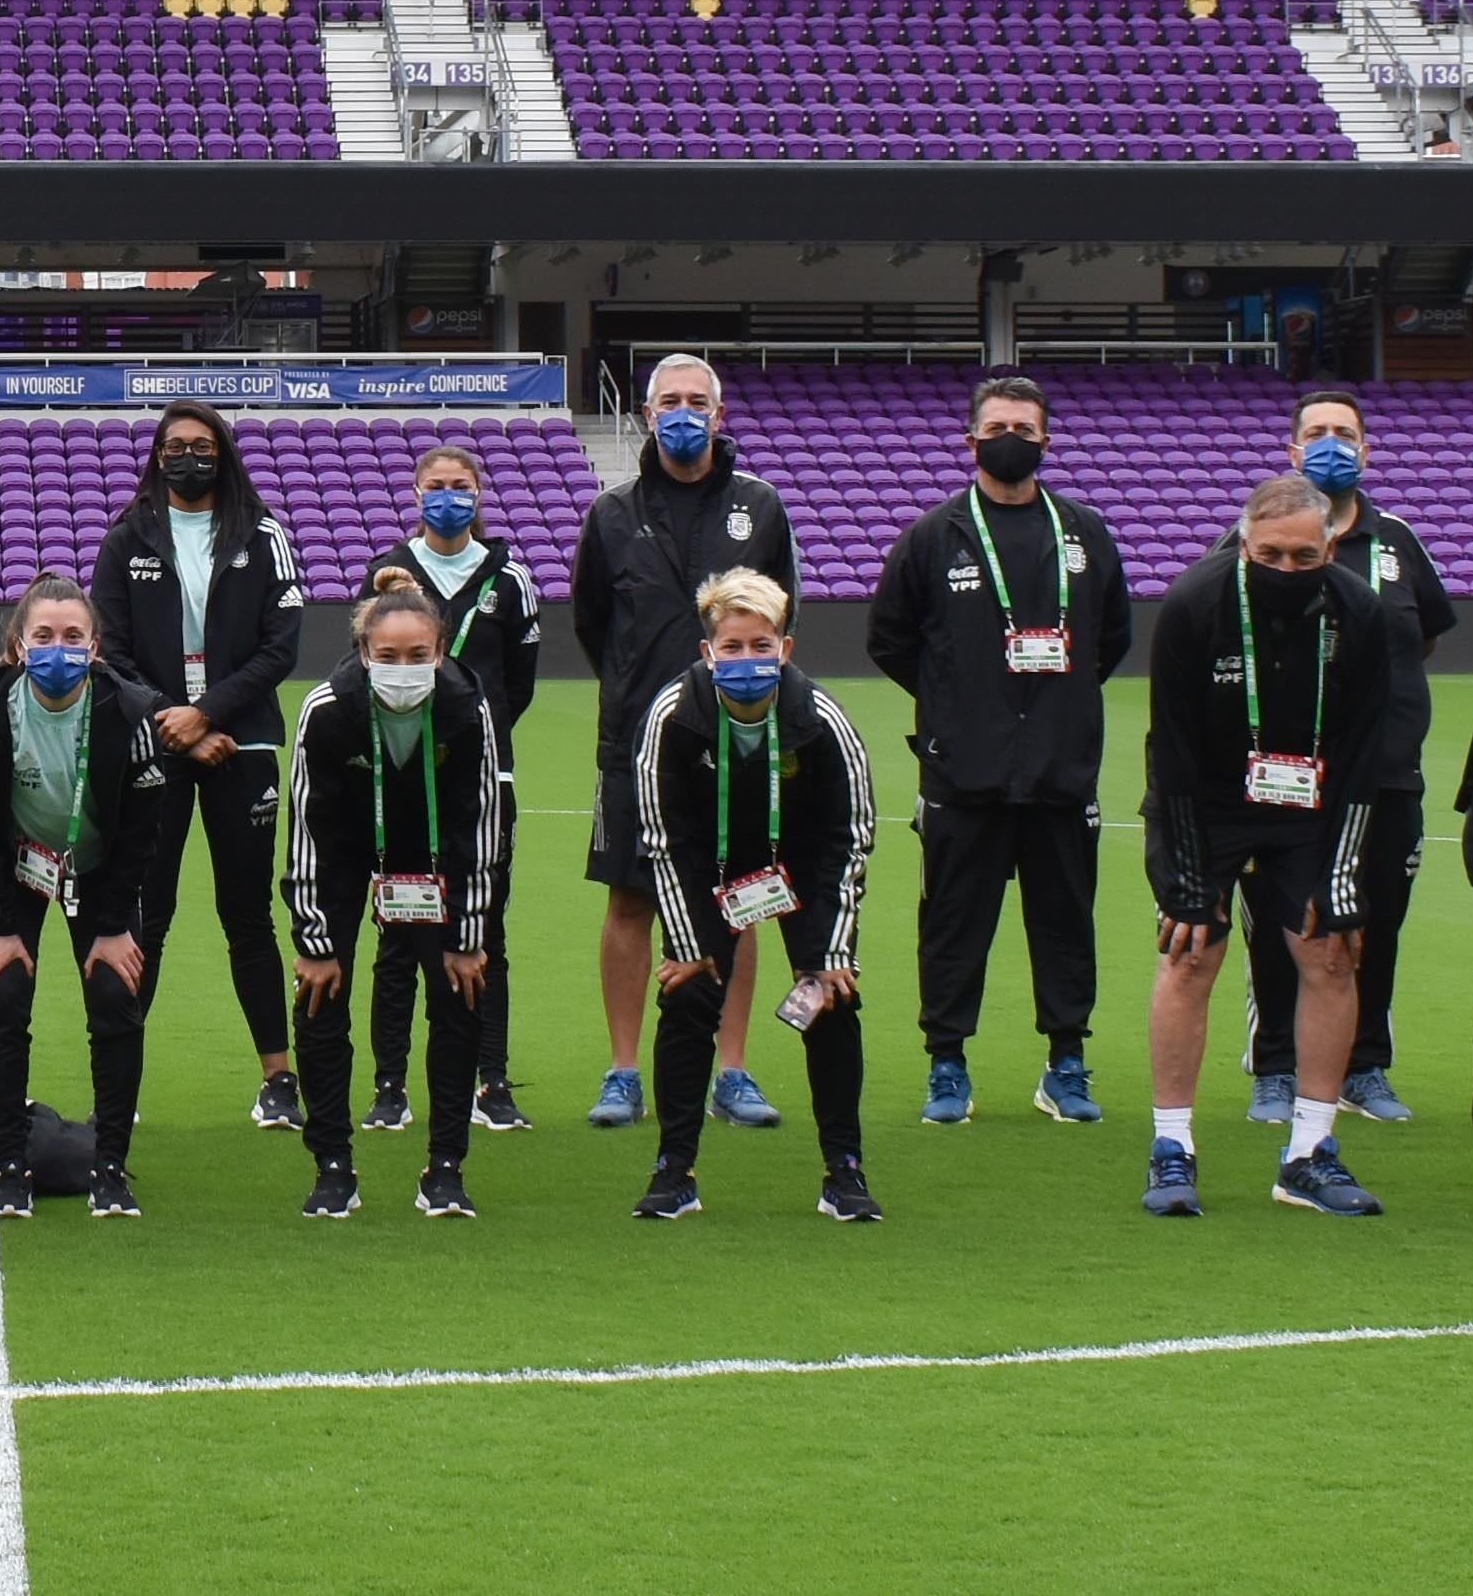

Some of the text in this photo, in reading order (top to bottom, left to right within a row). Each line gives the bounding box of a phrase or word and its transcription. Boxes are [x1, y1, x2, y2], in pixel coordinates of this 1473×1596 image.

[446, 64, 484, 83] 135
[1423, 65, 1461, 84] 136
[435, 307, 481, 325] pepsi
[1422, 308, 1468, 326] pepsi
[6, 377, 18, 395] IN
[19, 377, 85, 395] YOURSELF
[132, 377, 274, 394] SHEBELIEVES CUP
[285, 382, 330, 399] VISA
[358, 374, 508, 397] inspire CONFIDENCE
[129, 570, 162, 581] YPF
[949, 579, 981, 592] YPF
[1212, 671, 1244, 684] YPF
